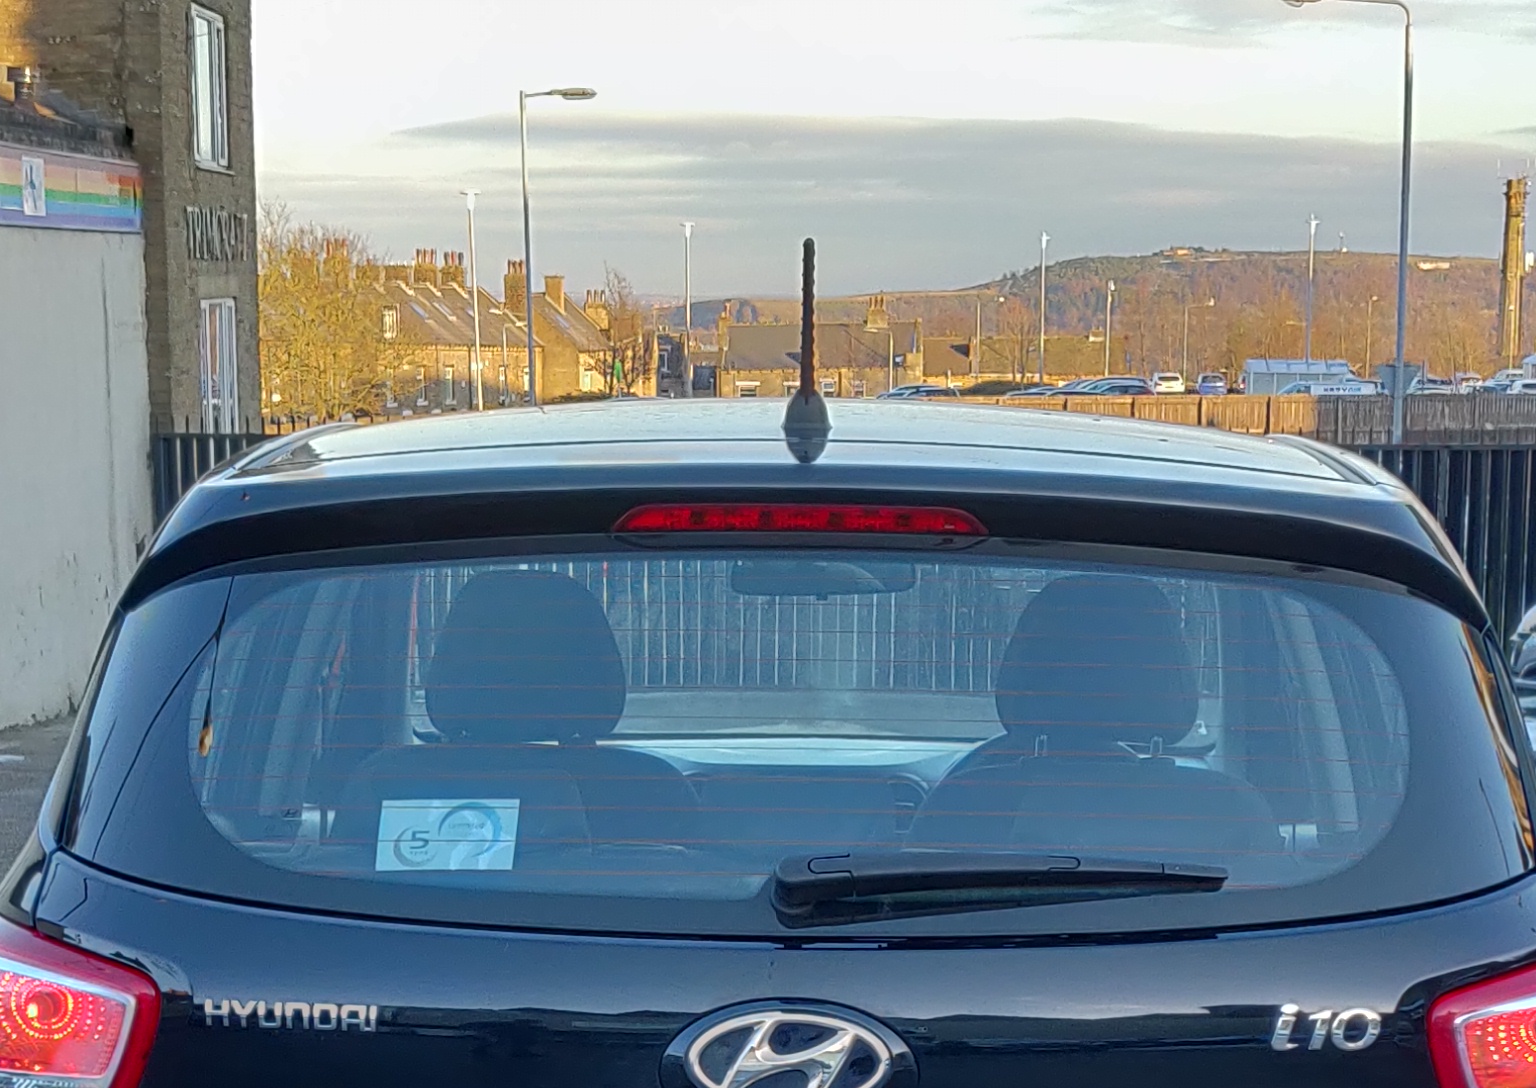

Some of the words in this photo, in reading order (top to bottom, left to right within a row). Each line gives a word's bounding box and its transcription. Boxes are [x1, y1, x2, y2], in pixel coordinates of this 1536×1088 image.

[409, 830, 431, 850] 5
[204, 999, 378, 1032] HYUNDAI
[1271, 1003, 1382, 1051] i10
